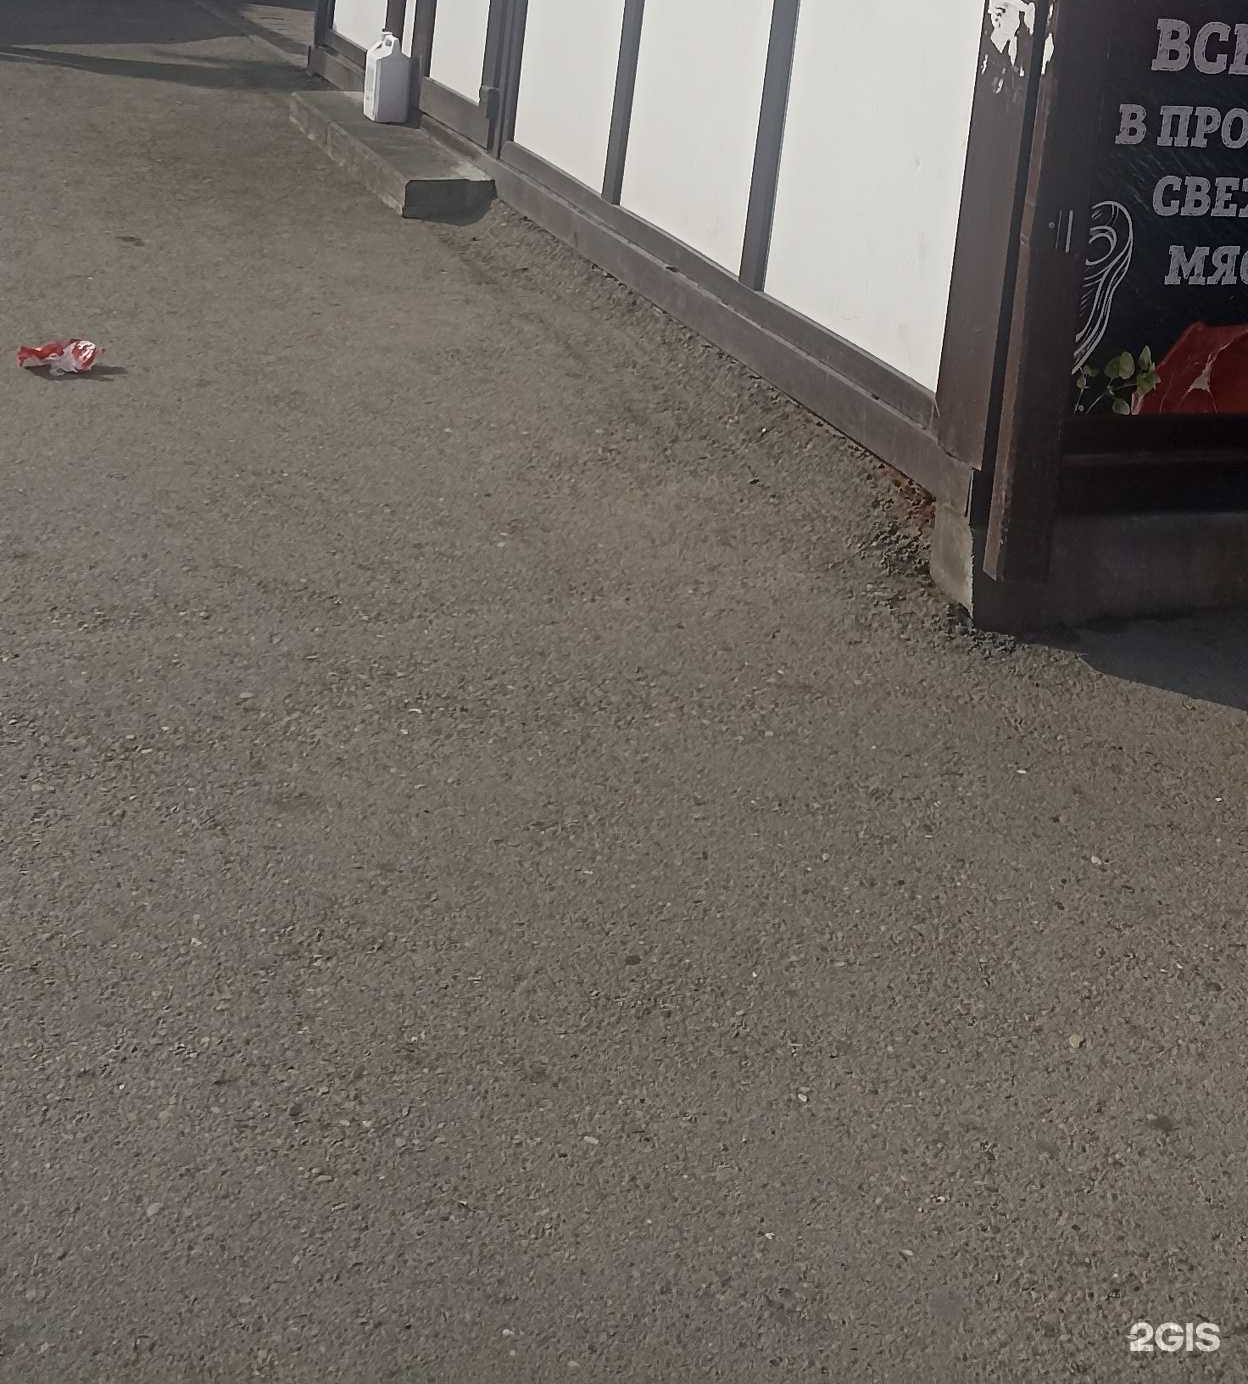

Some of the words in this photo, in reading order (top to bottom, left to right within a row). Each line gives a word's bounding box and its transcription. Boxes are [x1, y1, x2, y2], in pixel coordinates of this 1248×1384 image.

[1115, 103, 1148, 145] В
[1152, 175, 1248, 218] СВЕ
[1164, 244, 1248, 286] МЯ
